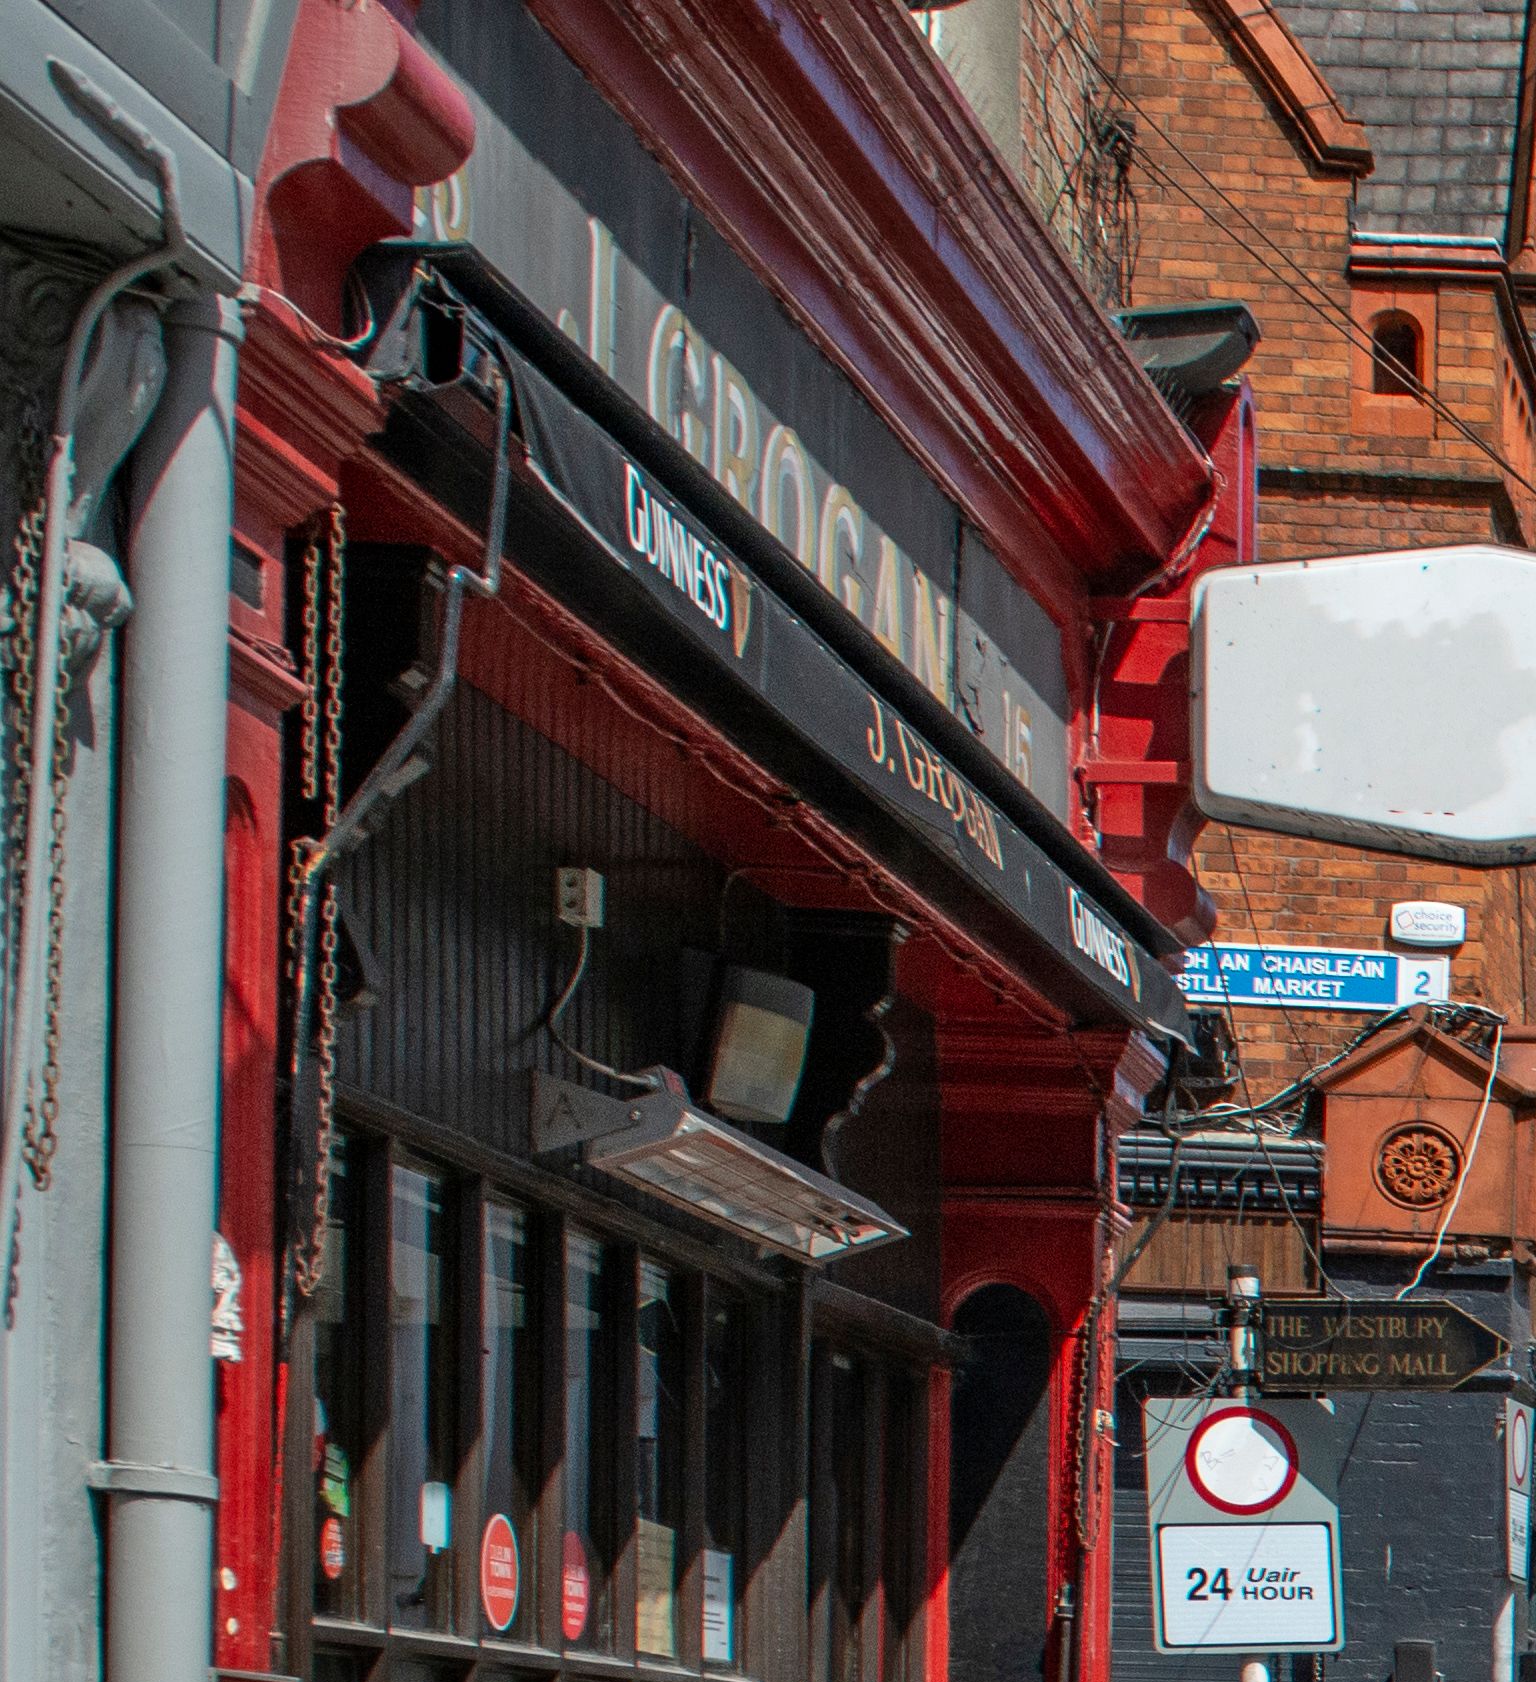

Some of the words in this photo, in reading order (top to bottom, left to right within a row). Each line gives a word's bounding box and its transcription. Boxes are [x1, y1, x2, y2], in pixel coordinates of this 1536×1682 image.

[624, 461, 728, 633] GUINNESS
[647, 300, 955, 707] GROGAN
[1002, 690, 1034, 789] 15
[866, 694, 895, 775] J.
[1413, 909, 1453, 921] choice
[1413, 920, 1458, 934] security
[1066, 886, 1130, 988] GUINNESS
[1219, 953, 1250, 972] AN
[1261, 955, 1385, 980] CHAISLEÁIN
[1413, 970, 1431, 997] 2
[1252, 976, 1346, 999] MARKET
[1266, 1315, 1312, 1338] THE
[1322, 1316, 1450, 1339] WESTBURY
[1266, 1351, 1380, 1377] SHOPPING
[1389, 1352, 1457, 1377] MALL
[1185, 1566, 1234, 1602] 24
[1246, 1566, 1302, 1583] Uair
[1241, 1585, 1314, 1601] HOUR
